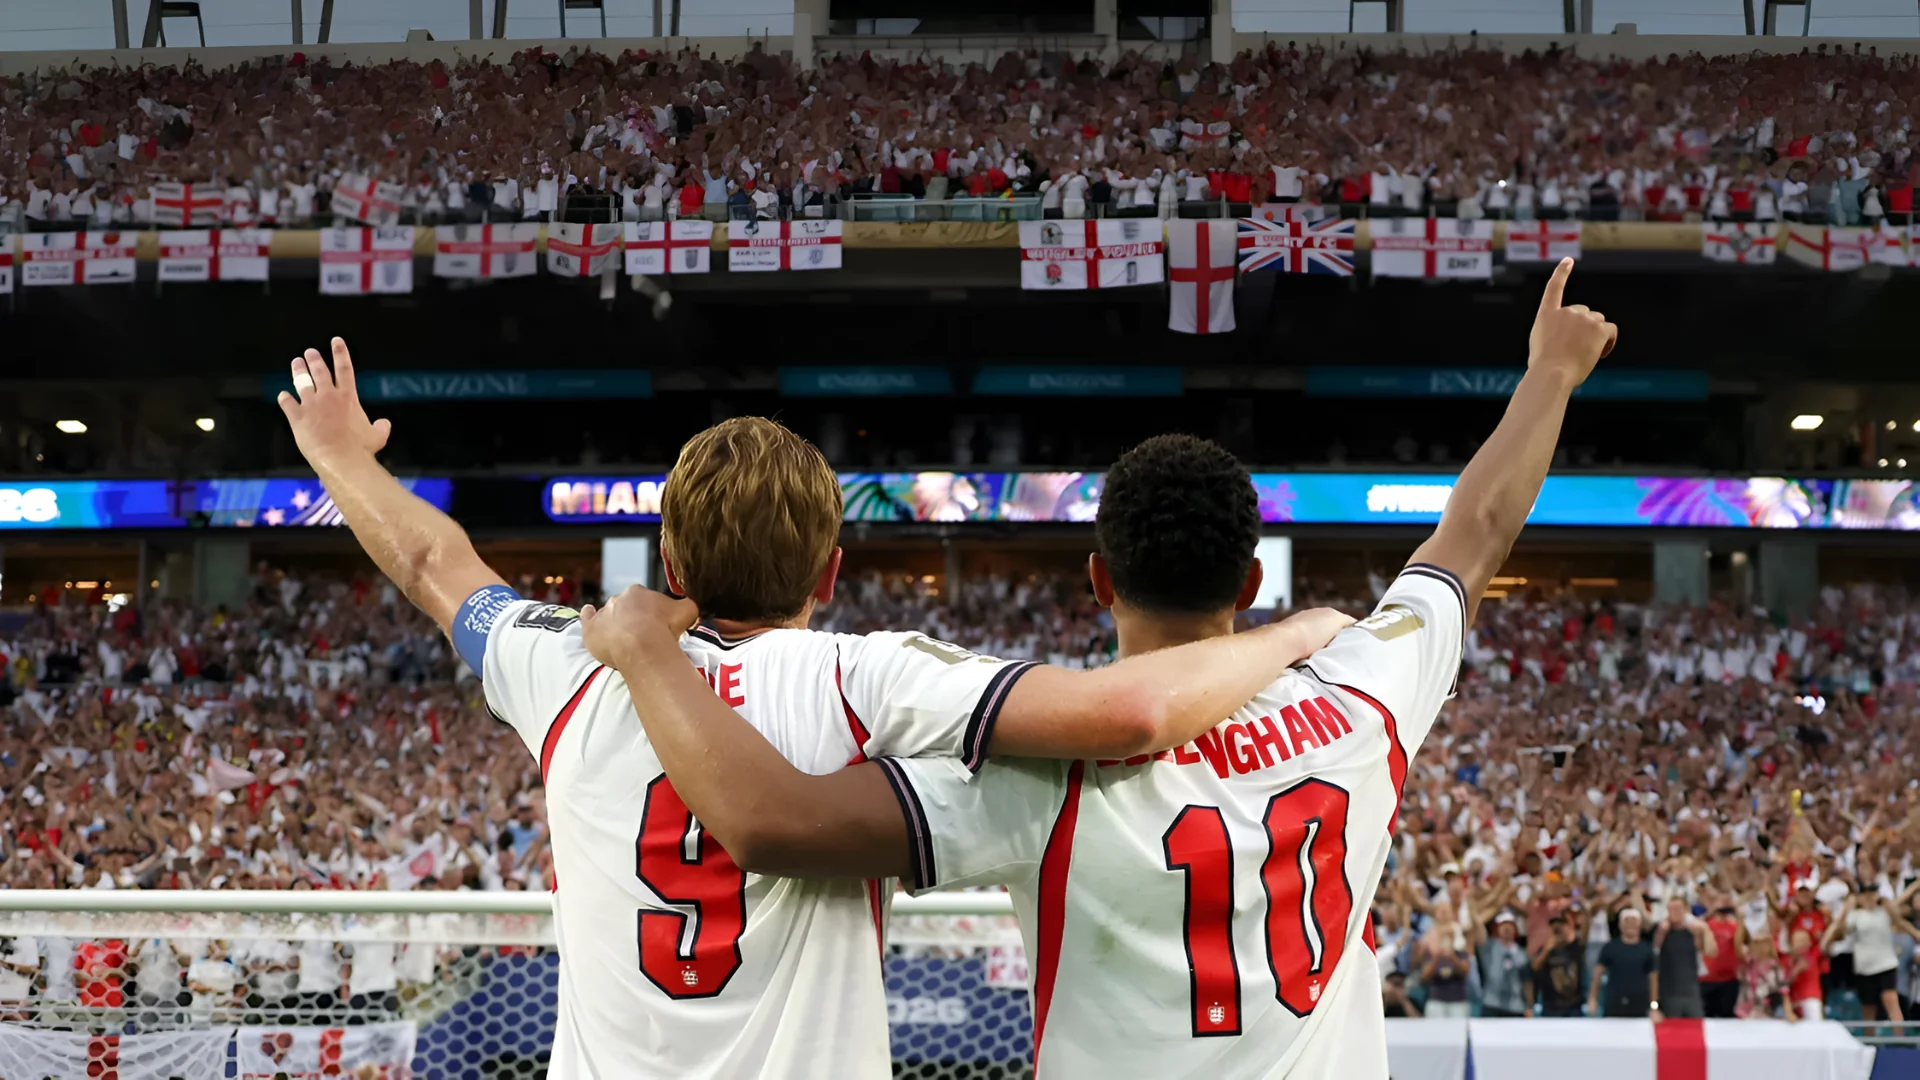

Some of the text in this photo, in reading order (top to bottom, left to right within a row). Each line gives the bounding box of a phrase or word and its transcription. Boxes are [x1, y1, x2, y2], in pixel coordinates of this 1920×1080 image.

[1429, 370, 1521, 394] ENDZ
[551, 481, 667, 515] MIAM
[635, 771, 748, 1001] 9
[1161, 776, 1354, 1039] 10
[887, 997, 969, 1025] 026
